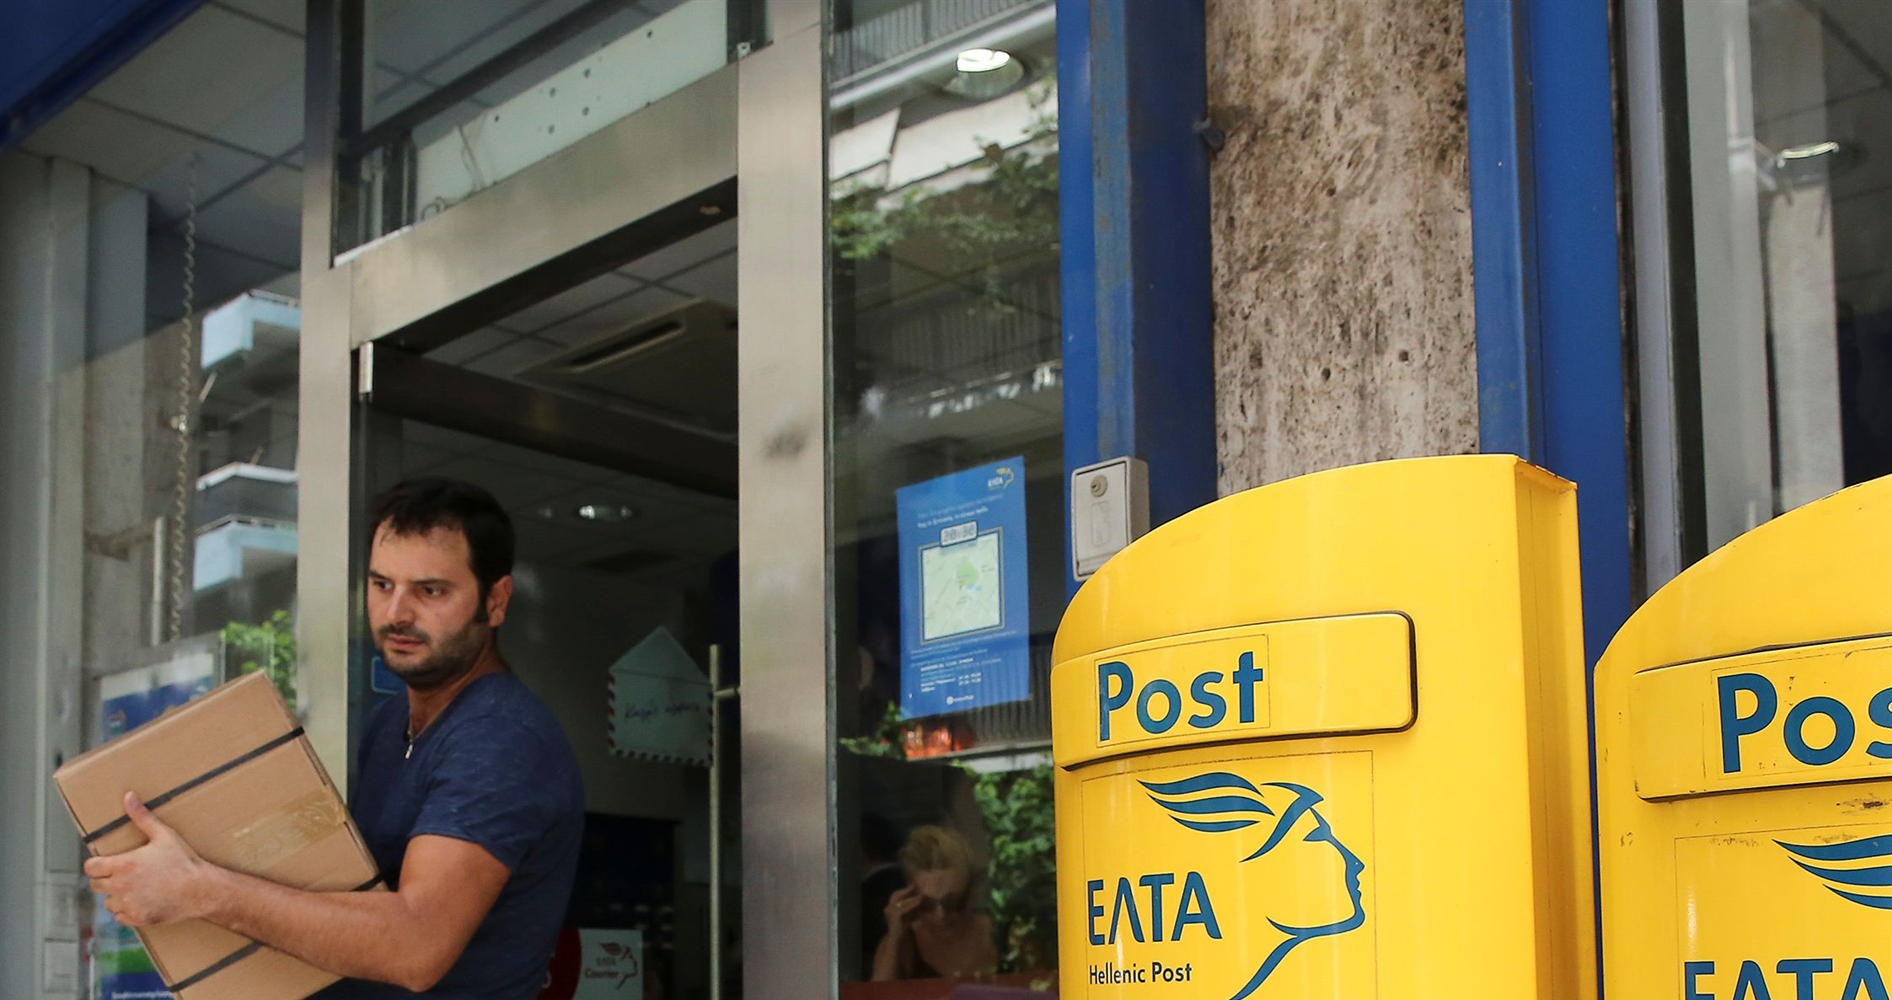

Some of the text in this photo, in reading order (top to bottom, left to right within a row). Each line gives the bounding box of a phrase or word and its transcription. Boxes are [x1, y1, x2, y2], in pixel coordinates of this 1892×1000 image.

[1098, 651, 1263, 741] Post
[1087, 870, 1222, 946] ΕΛΤΑ
[1089, 962, 1192, 985] Hellenic Post
